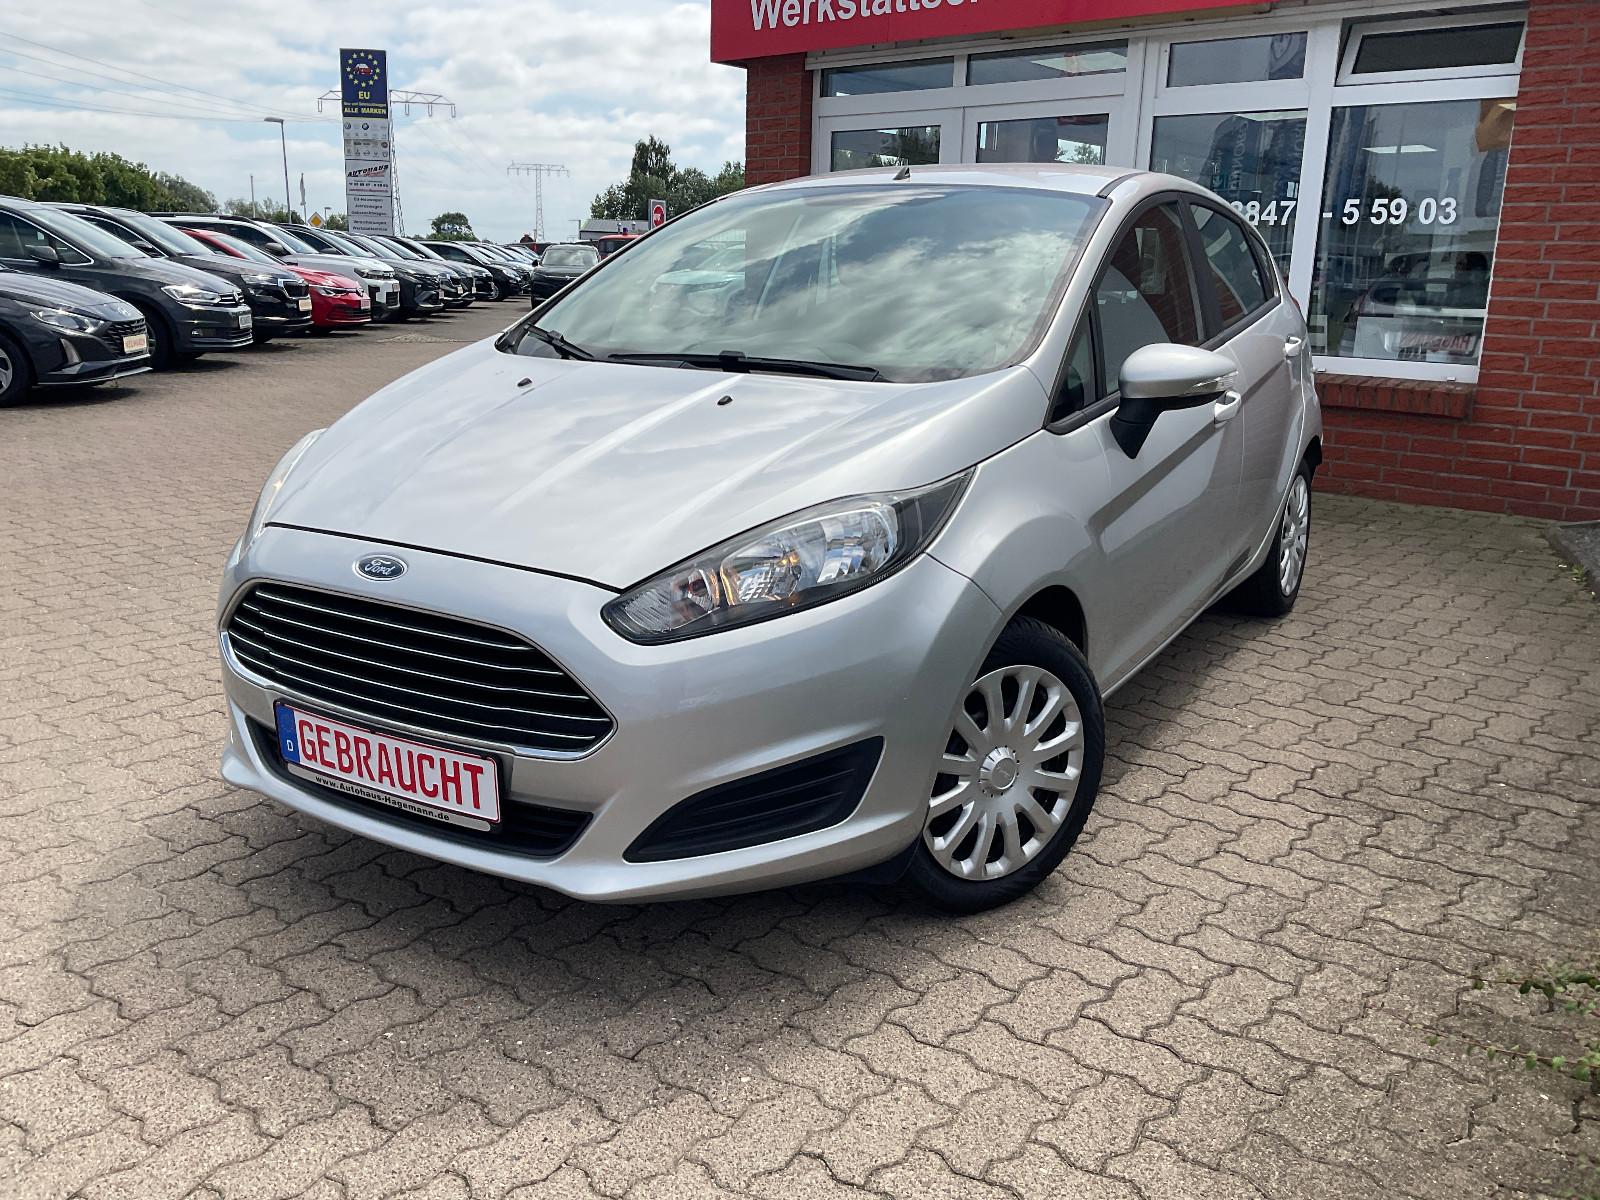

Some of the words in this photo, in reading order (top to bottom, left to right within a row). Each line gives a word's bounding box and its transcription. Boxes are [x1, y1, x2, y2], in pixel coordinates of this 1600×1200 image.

[358, 91, 370, 100] EU
[1342, 198, 1361, 225] 5
[1370, 198, 1408, 225] 59
[1418, 197, 1457, 225] 03
[364, 559, 396, 576] Ford
[286, 739, 294, 752] D
[298, 718, 484, 810] GEBRAUCHT
[314, 774, 450, 822] www.Autohaus-Hagemann.de
